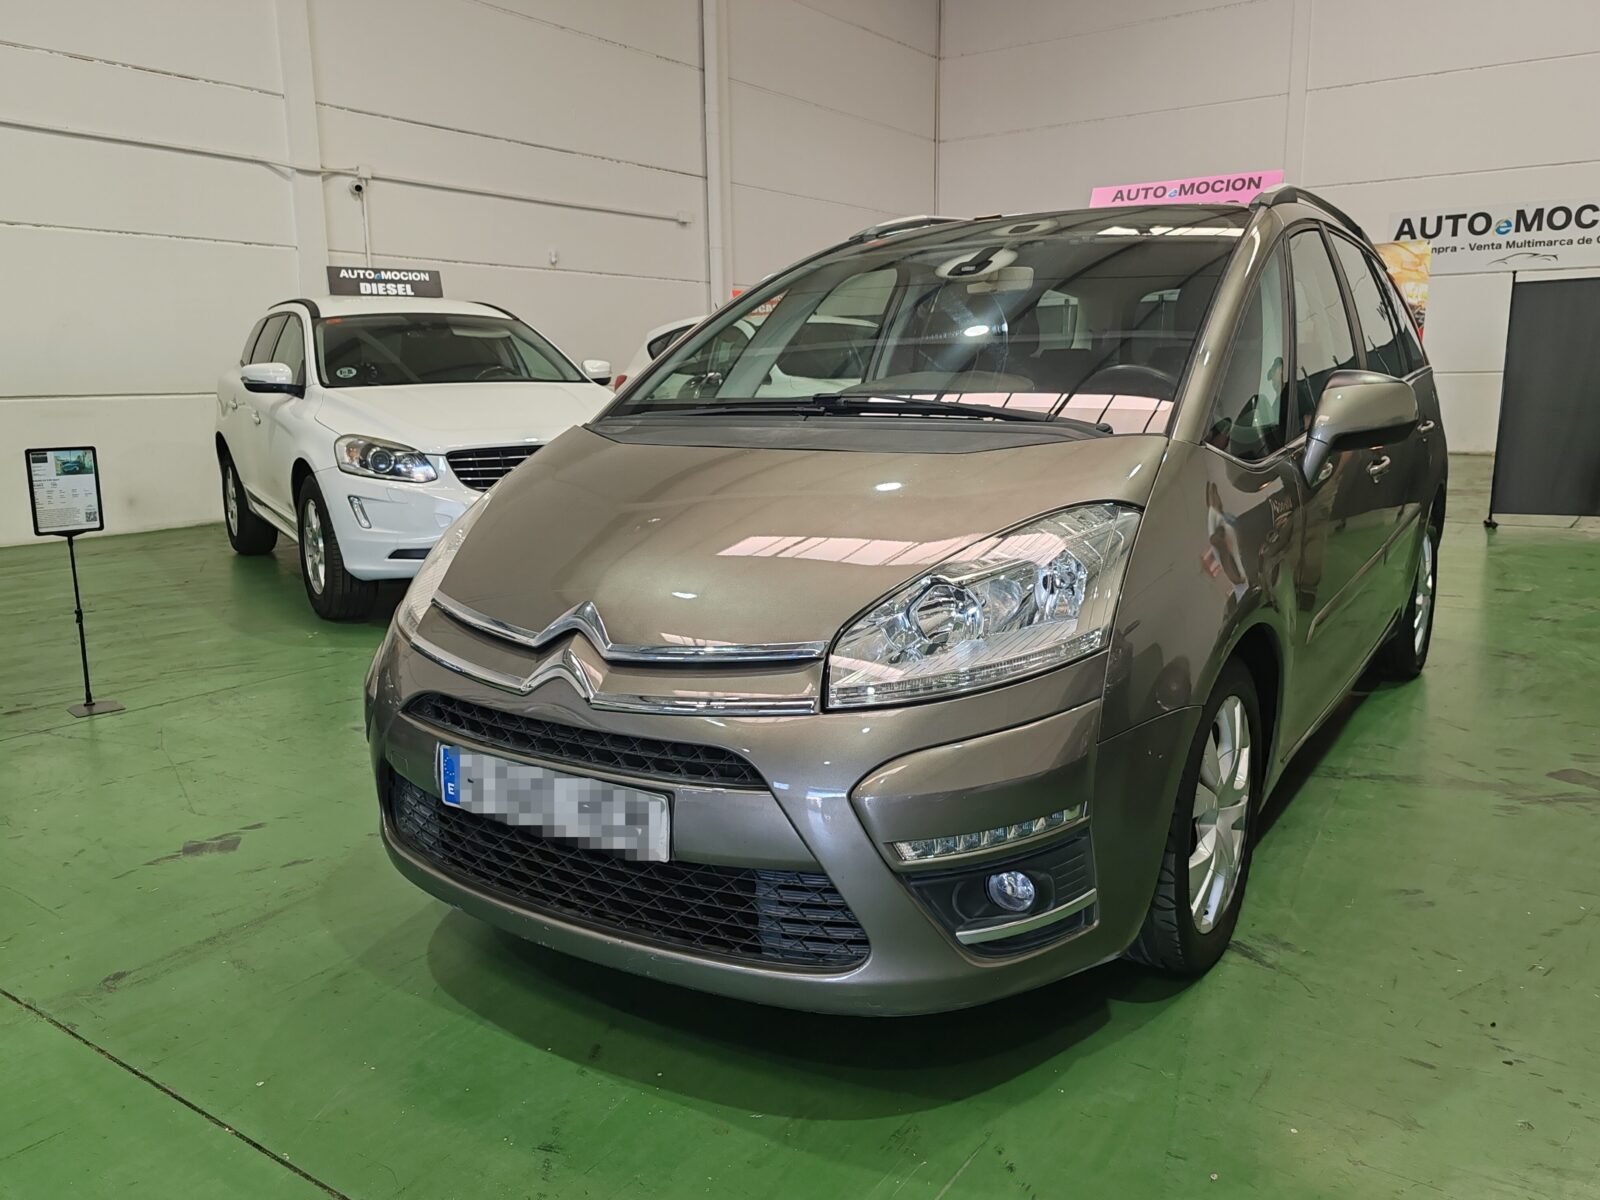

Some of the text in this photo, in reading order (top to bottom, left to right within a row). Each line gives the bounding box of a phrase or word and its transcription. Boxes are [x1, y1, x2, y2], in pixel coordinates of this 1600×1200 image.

[1468, 242, 1502, 252] Venta
[1506, 237, 1574, 249] Multimarca
[1577, 236, 1593, 245] de
[359, 282, 415, 296] DIESEL
[447, 782, 455, 796] E
